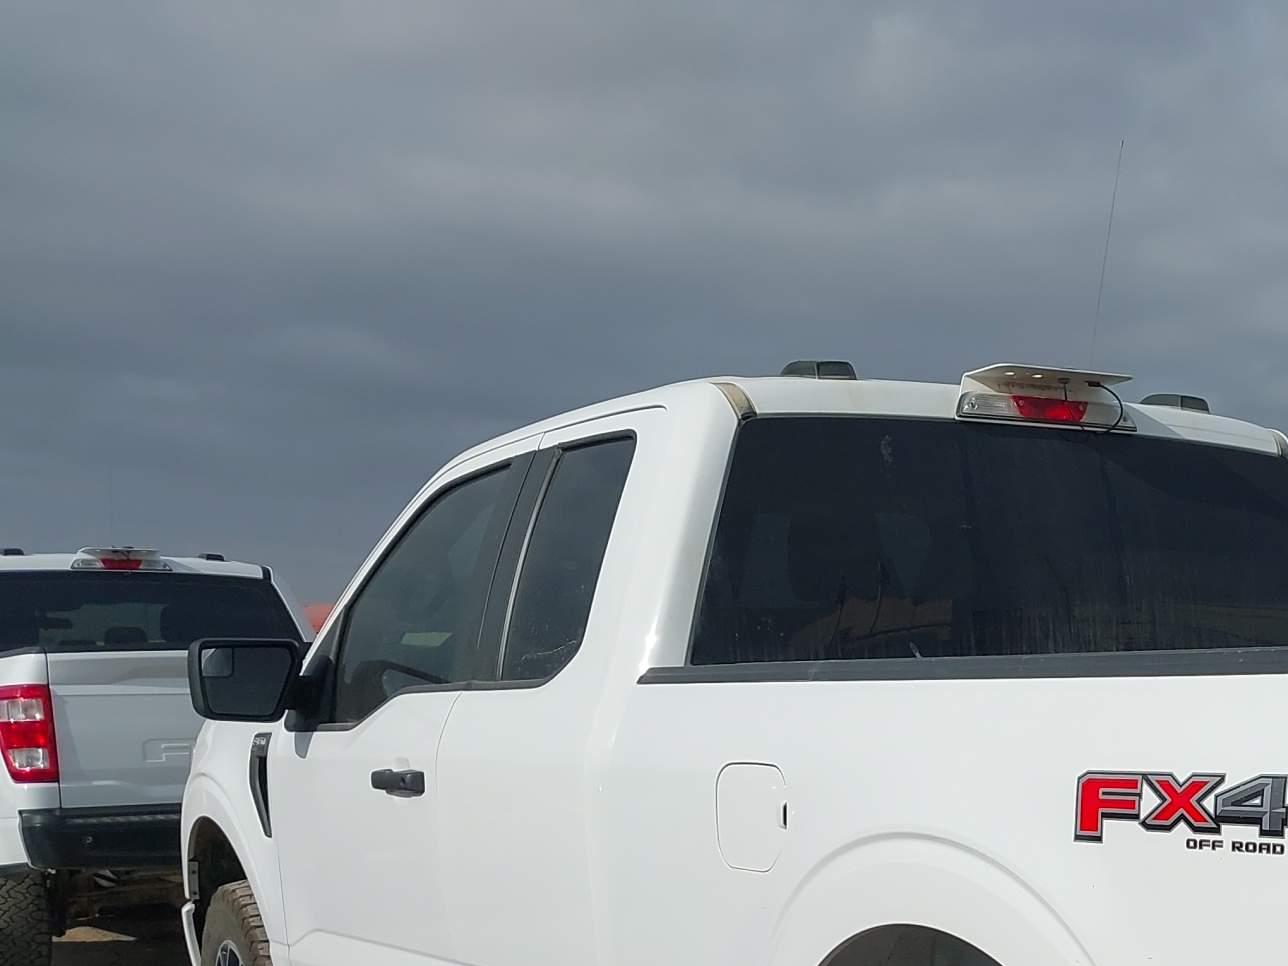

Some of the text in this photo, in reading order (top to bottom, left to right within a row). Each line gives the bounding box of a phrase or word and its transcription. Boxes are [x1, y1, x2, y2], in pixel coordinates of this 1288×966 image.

[1073, 770, 1288, 843] FX4
[1186, 838, 1285, 855] OFF ROAD
